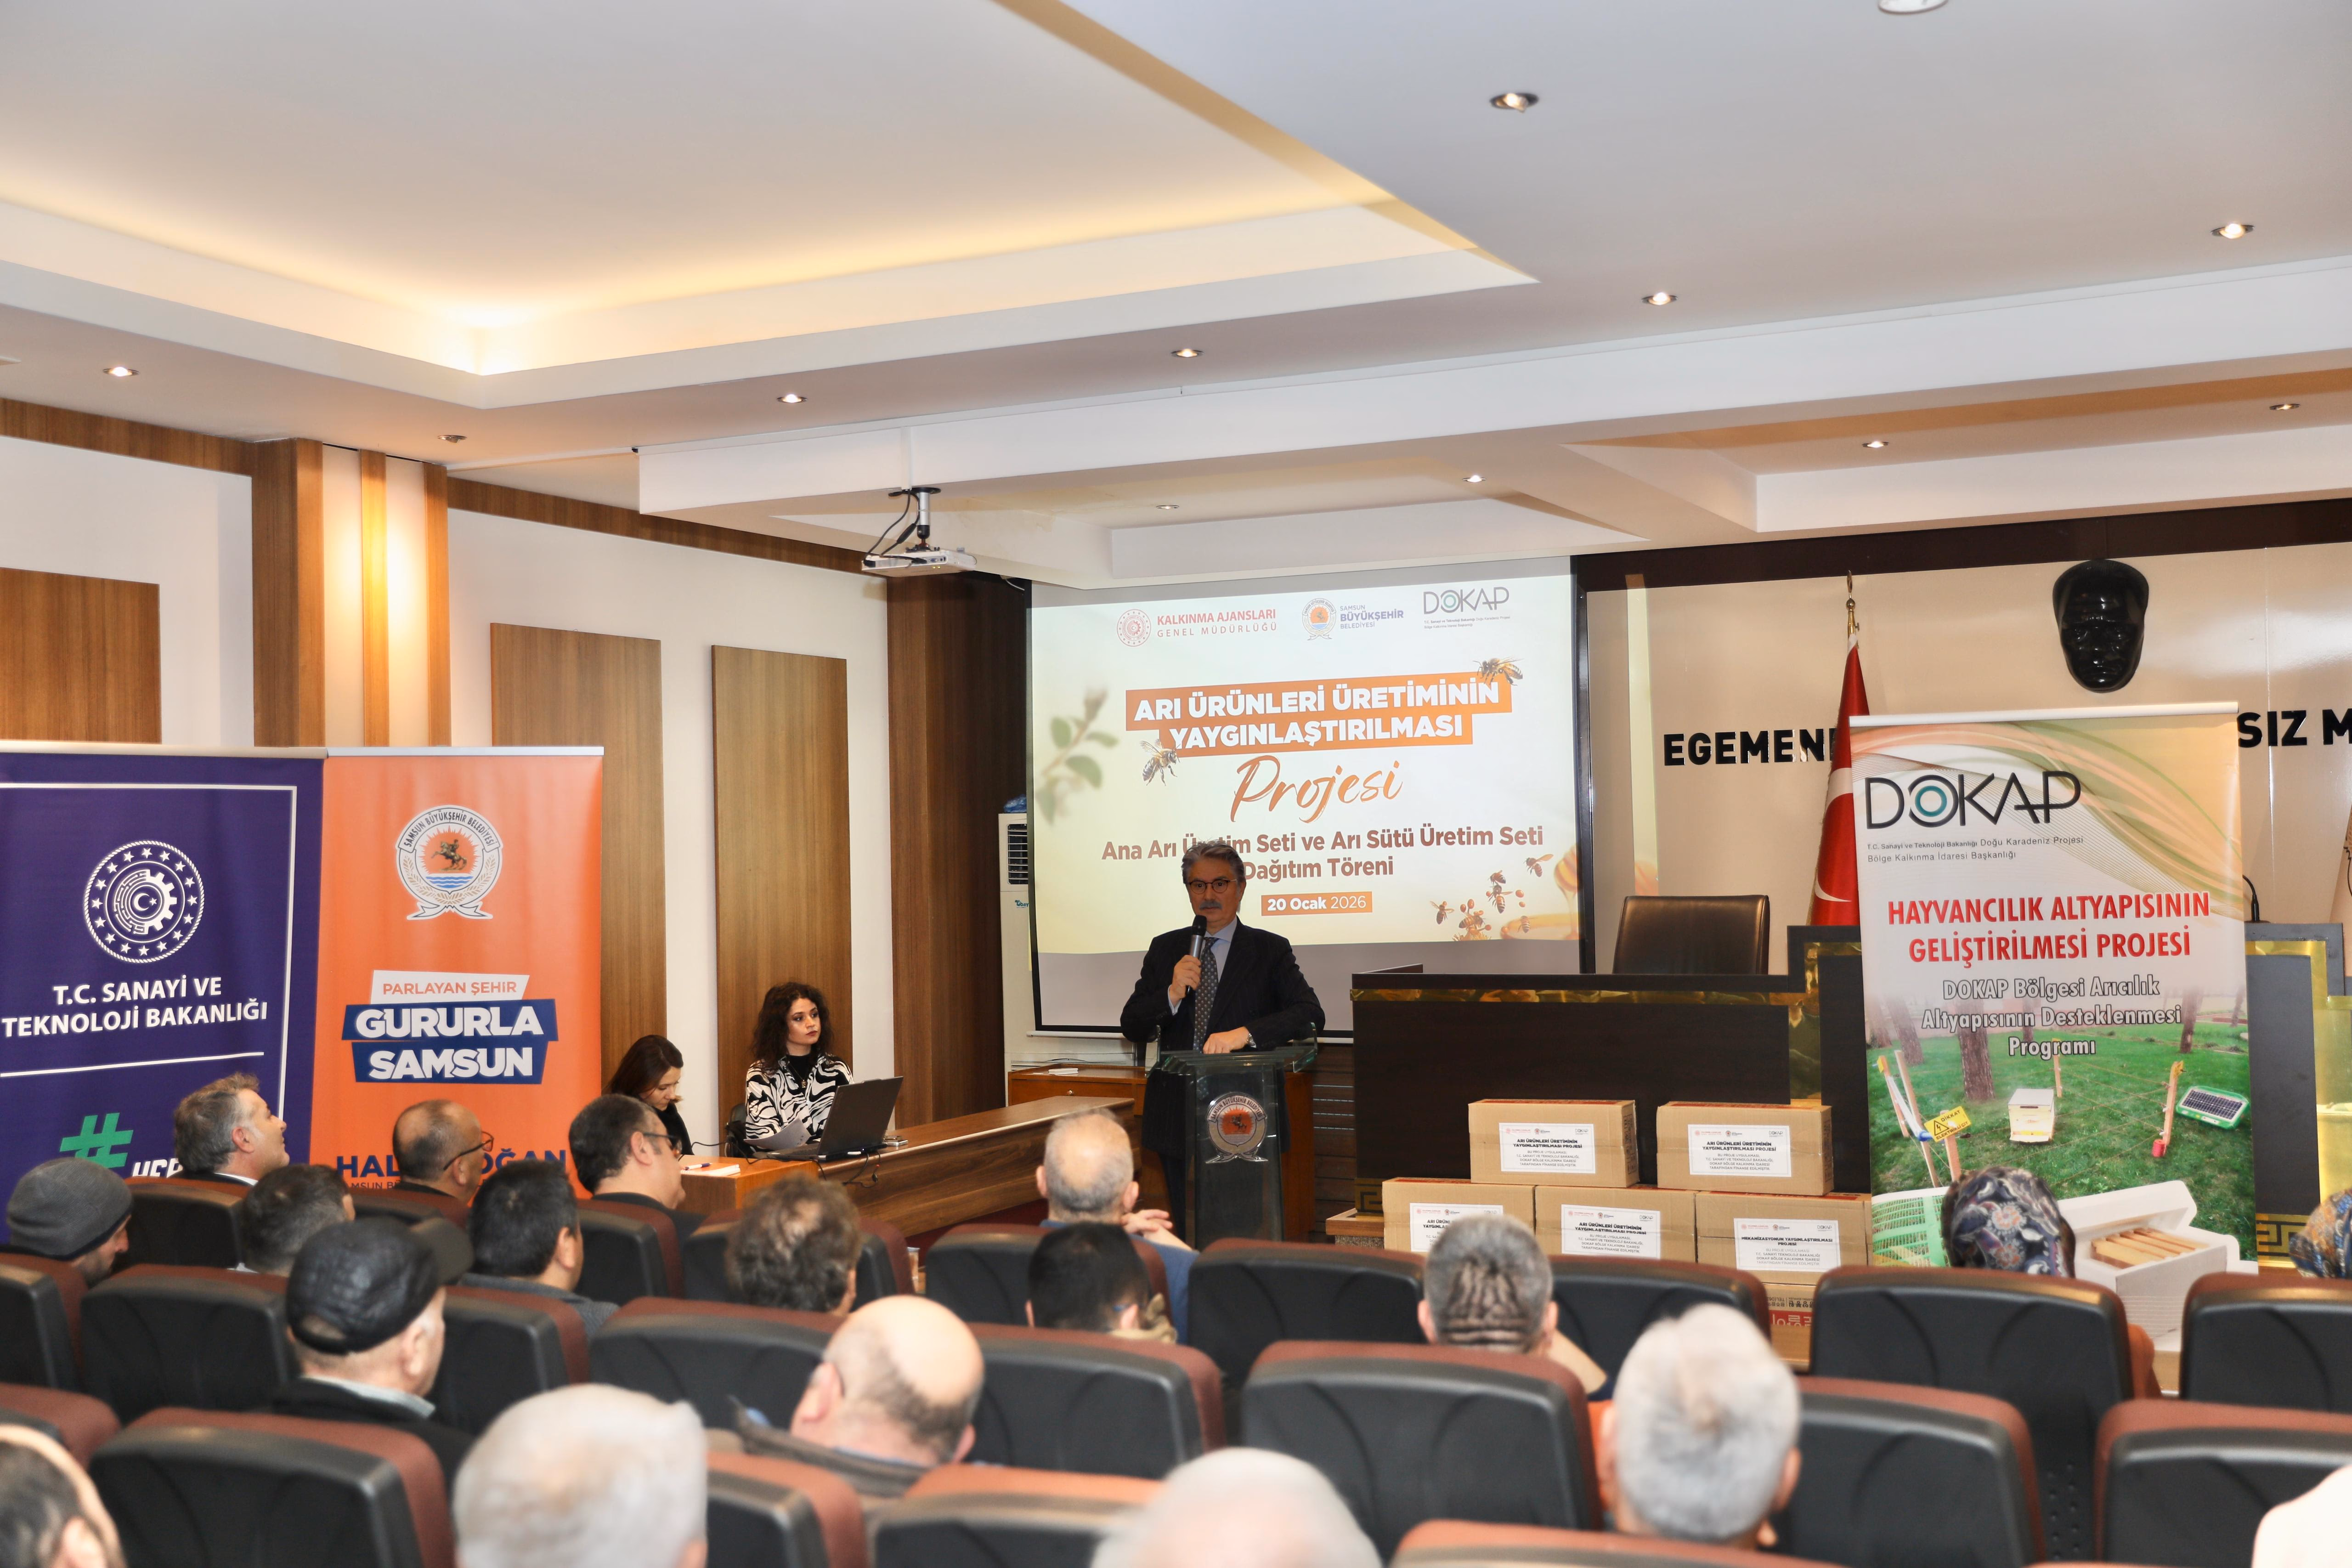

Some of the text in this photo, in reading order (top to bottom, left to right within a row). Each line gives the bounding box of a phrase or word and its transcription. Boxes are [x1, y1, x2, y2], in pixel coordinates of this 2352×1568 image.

[1423, 587, 1510, 614] DOKAP
[1157, 609, 1276, 626] KALKINMA AJANSLARI
[1340, 609, 1404, 621] BÜYÜKŞEHİR
[1340, 621, 1375, 629] BELEDİYESİ
[1157, 622, 1277, 638] GENEL MÜDÜRLÜĞÜ
[1134, 677, 1499, 721] ARI ÜRÜNLERİ ÜRETİMİNİN
[1170, 714, 1462, 749] YAYGINLAŞTIRILMASI
[1230, 755, 1403, 823] Projesi
[1865, 770, 2081, 829] DOKAP
[404, 809, 498, 847] SAMSUN BÜYÜKŞEHİR BELEDİYESİ
[1102, 841, 1142, 860] Ana
[1148, 840, 1176, 858] Arı
[1257, 832, 1295, 852] Seti
[1301, 835, 1325, 851] ve
[1332, 831, 1361, 849] Arı
[1367, 828, 1414, 848] Sütü
[1419, 823, 1493, 846] Üretim
[1499, 826, 1544, 846] Seti
[1946, 840, 1978, 848] Bakanlığı
[1980, 838, 2003, 848] Doğu
[2006, 837, 2050, 846] Karadeniz
[2053, 836, 2083, 845] Projesi
[1327, 856, 1394, 877] Töreni
[1868, 851, 2016, 863] Bölge Kalkınma İdaresi Başkanlığı
[1267, 895, 1366, 911] 20 Ocak 2026
[1888, 892, 2210, 925] HAYVANCILIK ALTYAPISININ
[1909, 925, 2190, 968] GELİŞTİRİLMESİ PROJESİ
[53, 974, 222, 1005] T.C. SANAYİ VE
[383, 982, 466, 995] PARLAYAN
[1943, 974, 2160, 1001] DOKAP Bölgesi Arıcılık
[1, 997, 267, 1037] TEKNOLOJİ BAKANLIĞI
[356, 1006, 544, 1038] GURURLA
[1921, 1004, 2182, 1034] Altyapısının Desteklenmesi
[2008, 1036, 2096, 1061] Programı
[369, 1047, 532, 1080] SAMSUN
[1211, 1104, 1223, 1119] SAMSUN
[1941, 1110, 1960, 1122] DİKKAT
